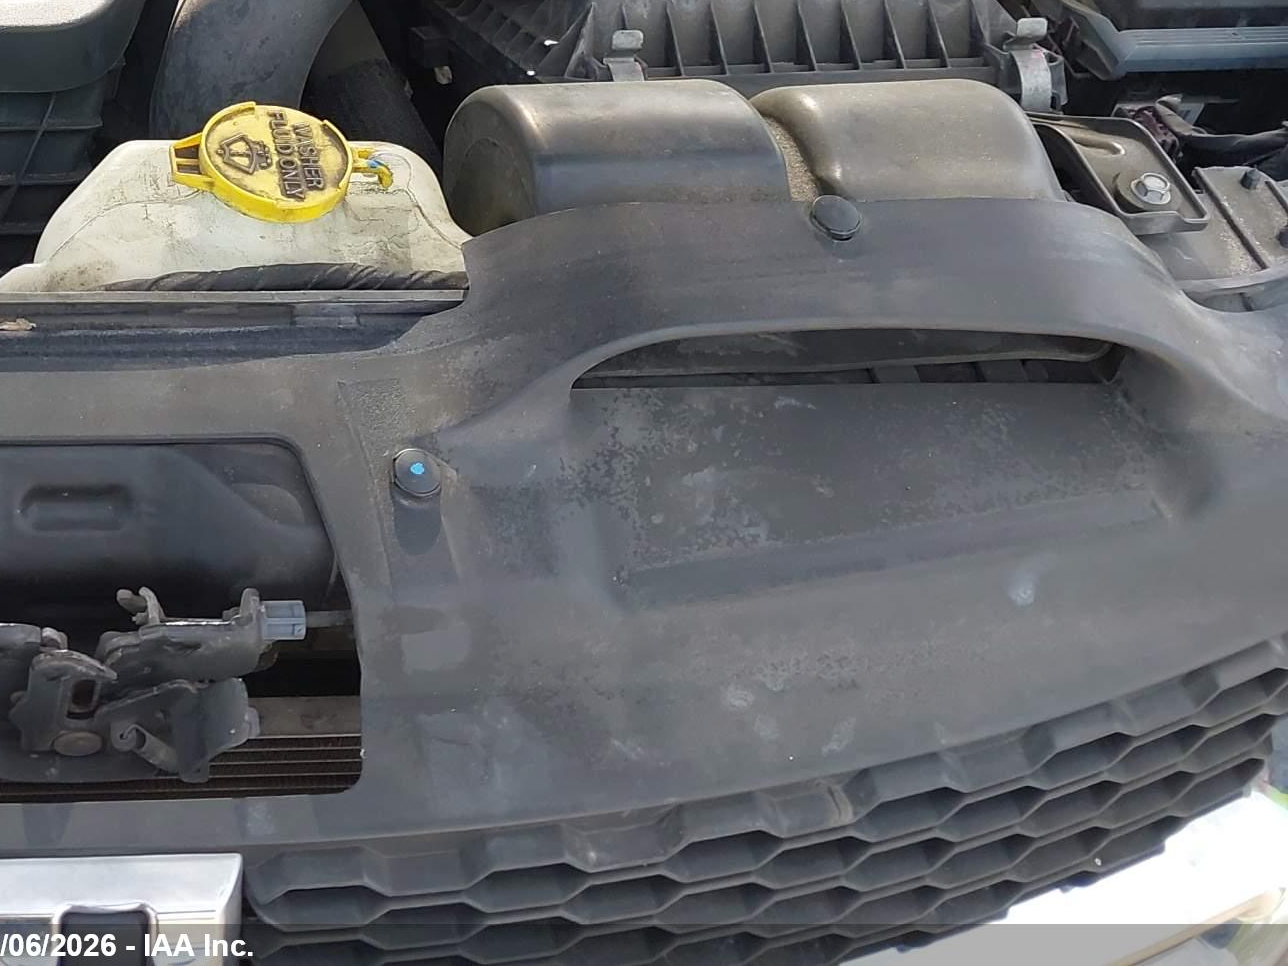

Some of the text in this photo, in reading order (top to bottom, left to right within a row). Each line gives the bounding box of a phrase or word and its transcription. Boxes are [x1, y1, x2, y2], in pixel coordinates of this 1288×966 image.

[267, 110, 306, 201] FLUID ONLY
[292, 121, 325, 189] WASHER
